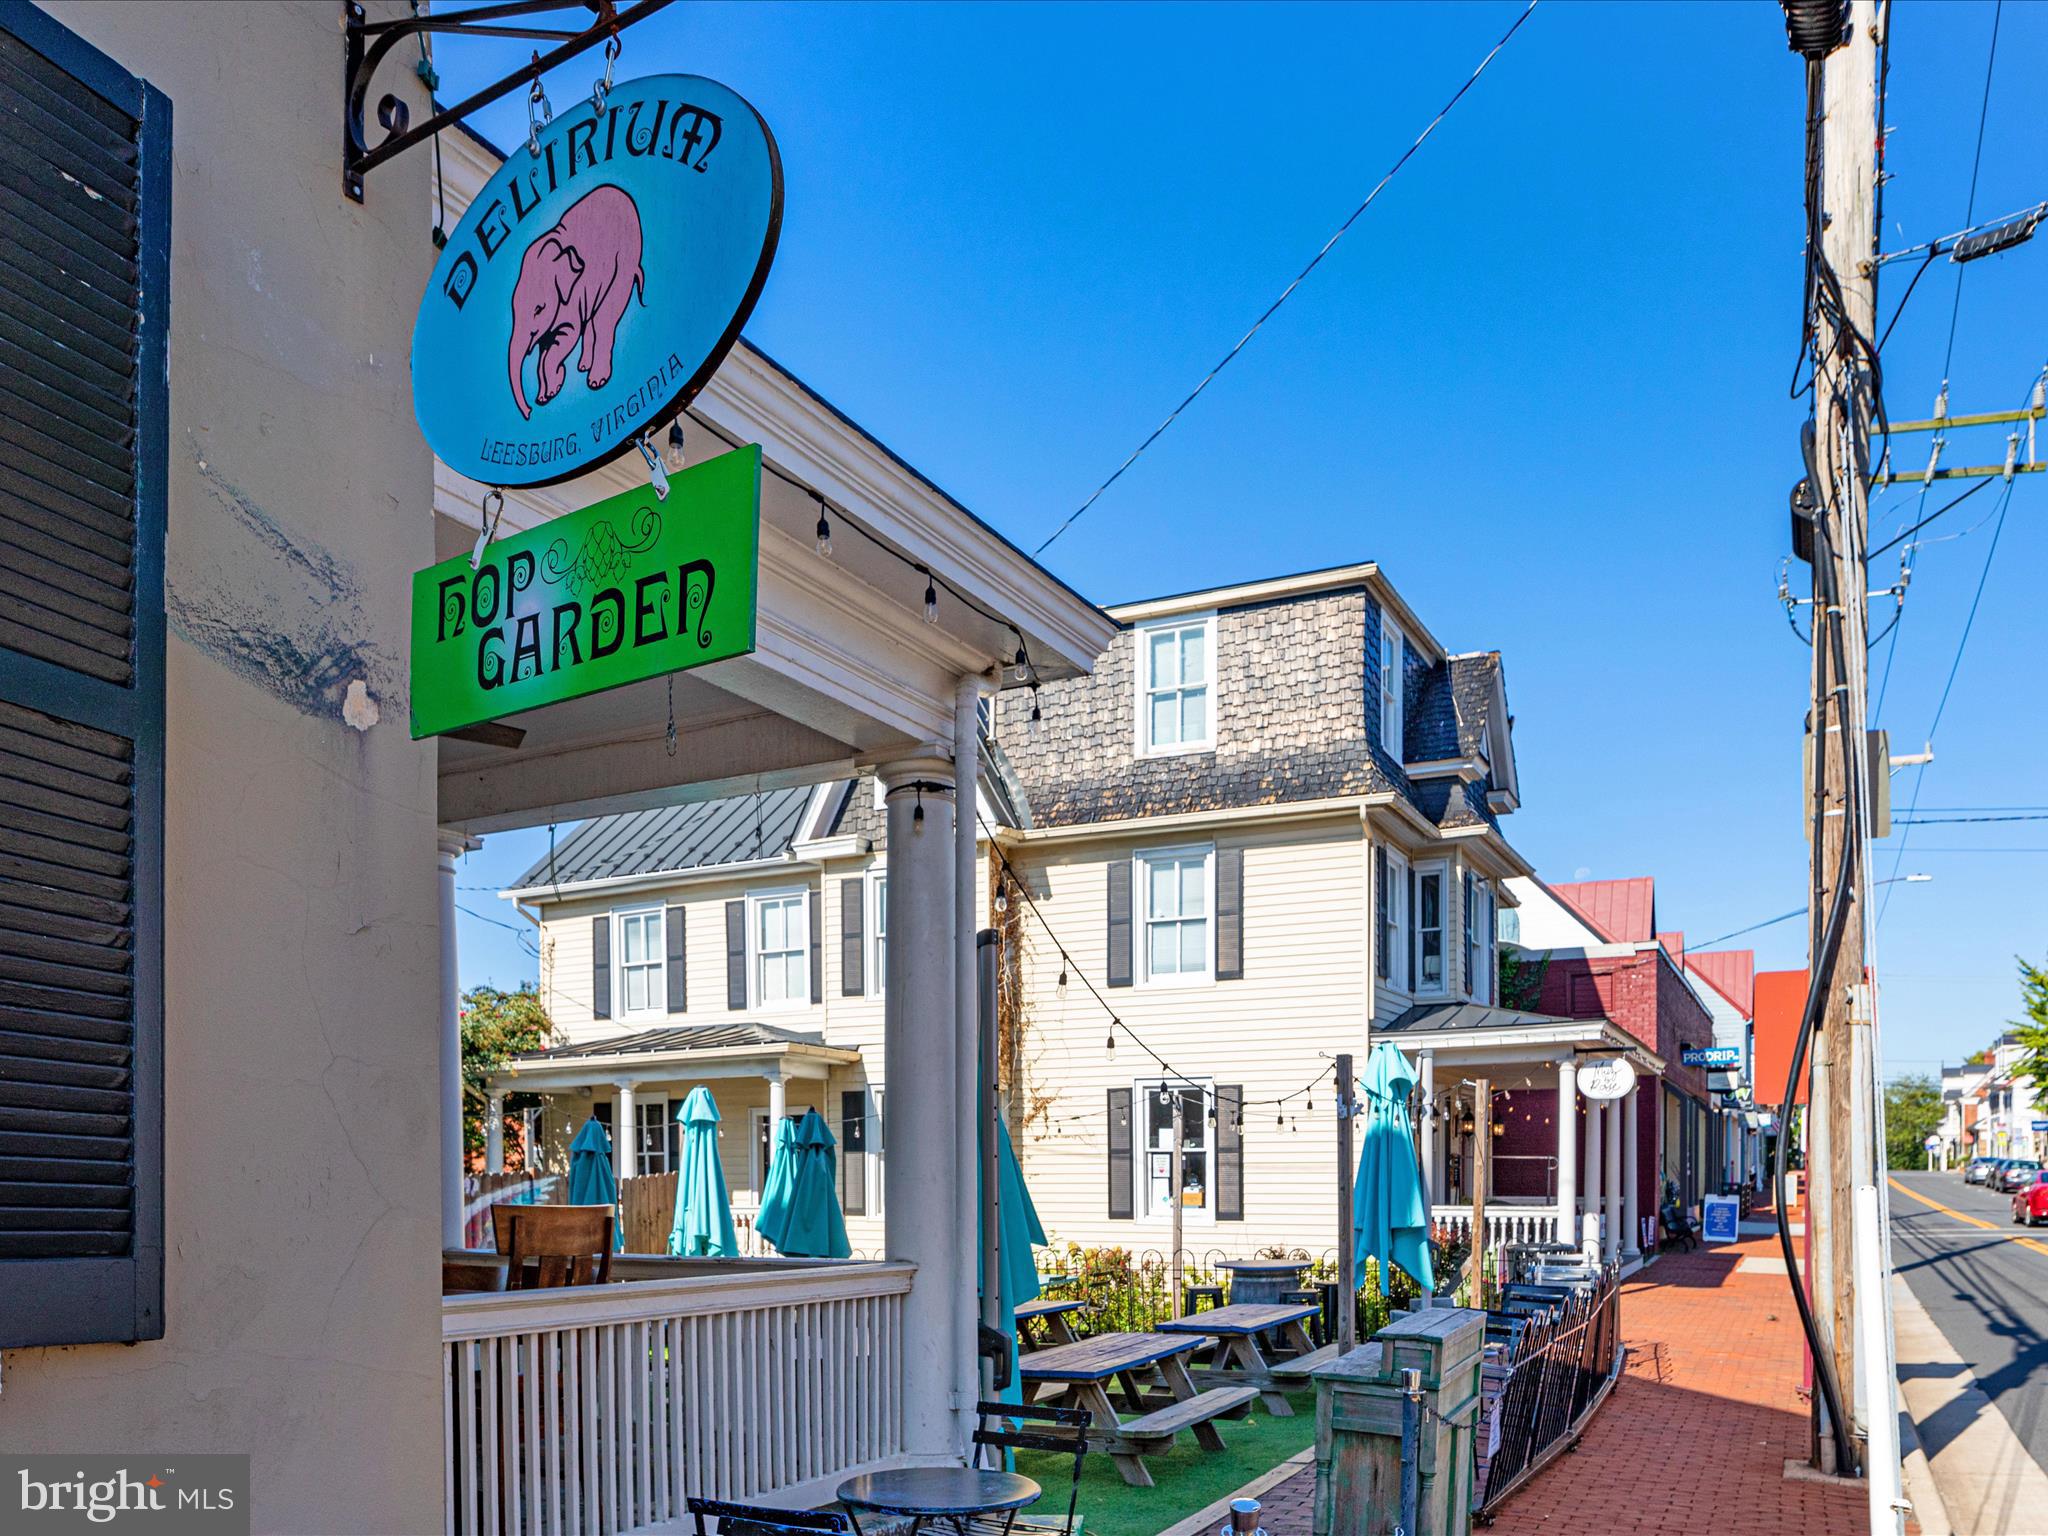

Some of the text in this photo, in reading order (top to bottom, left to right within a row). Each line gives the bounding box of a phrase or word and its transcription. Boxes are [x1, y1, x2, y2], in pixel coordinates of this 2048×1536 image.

[443, 100, 722, 312] DELIRIUM
[591, 353, 684, 443] VIRGINIA
[436, 550, 536, 643] HOP
[478, 558, 716, 690] GARDEN
